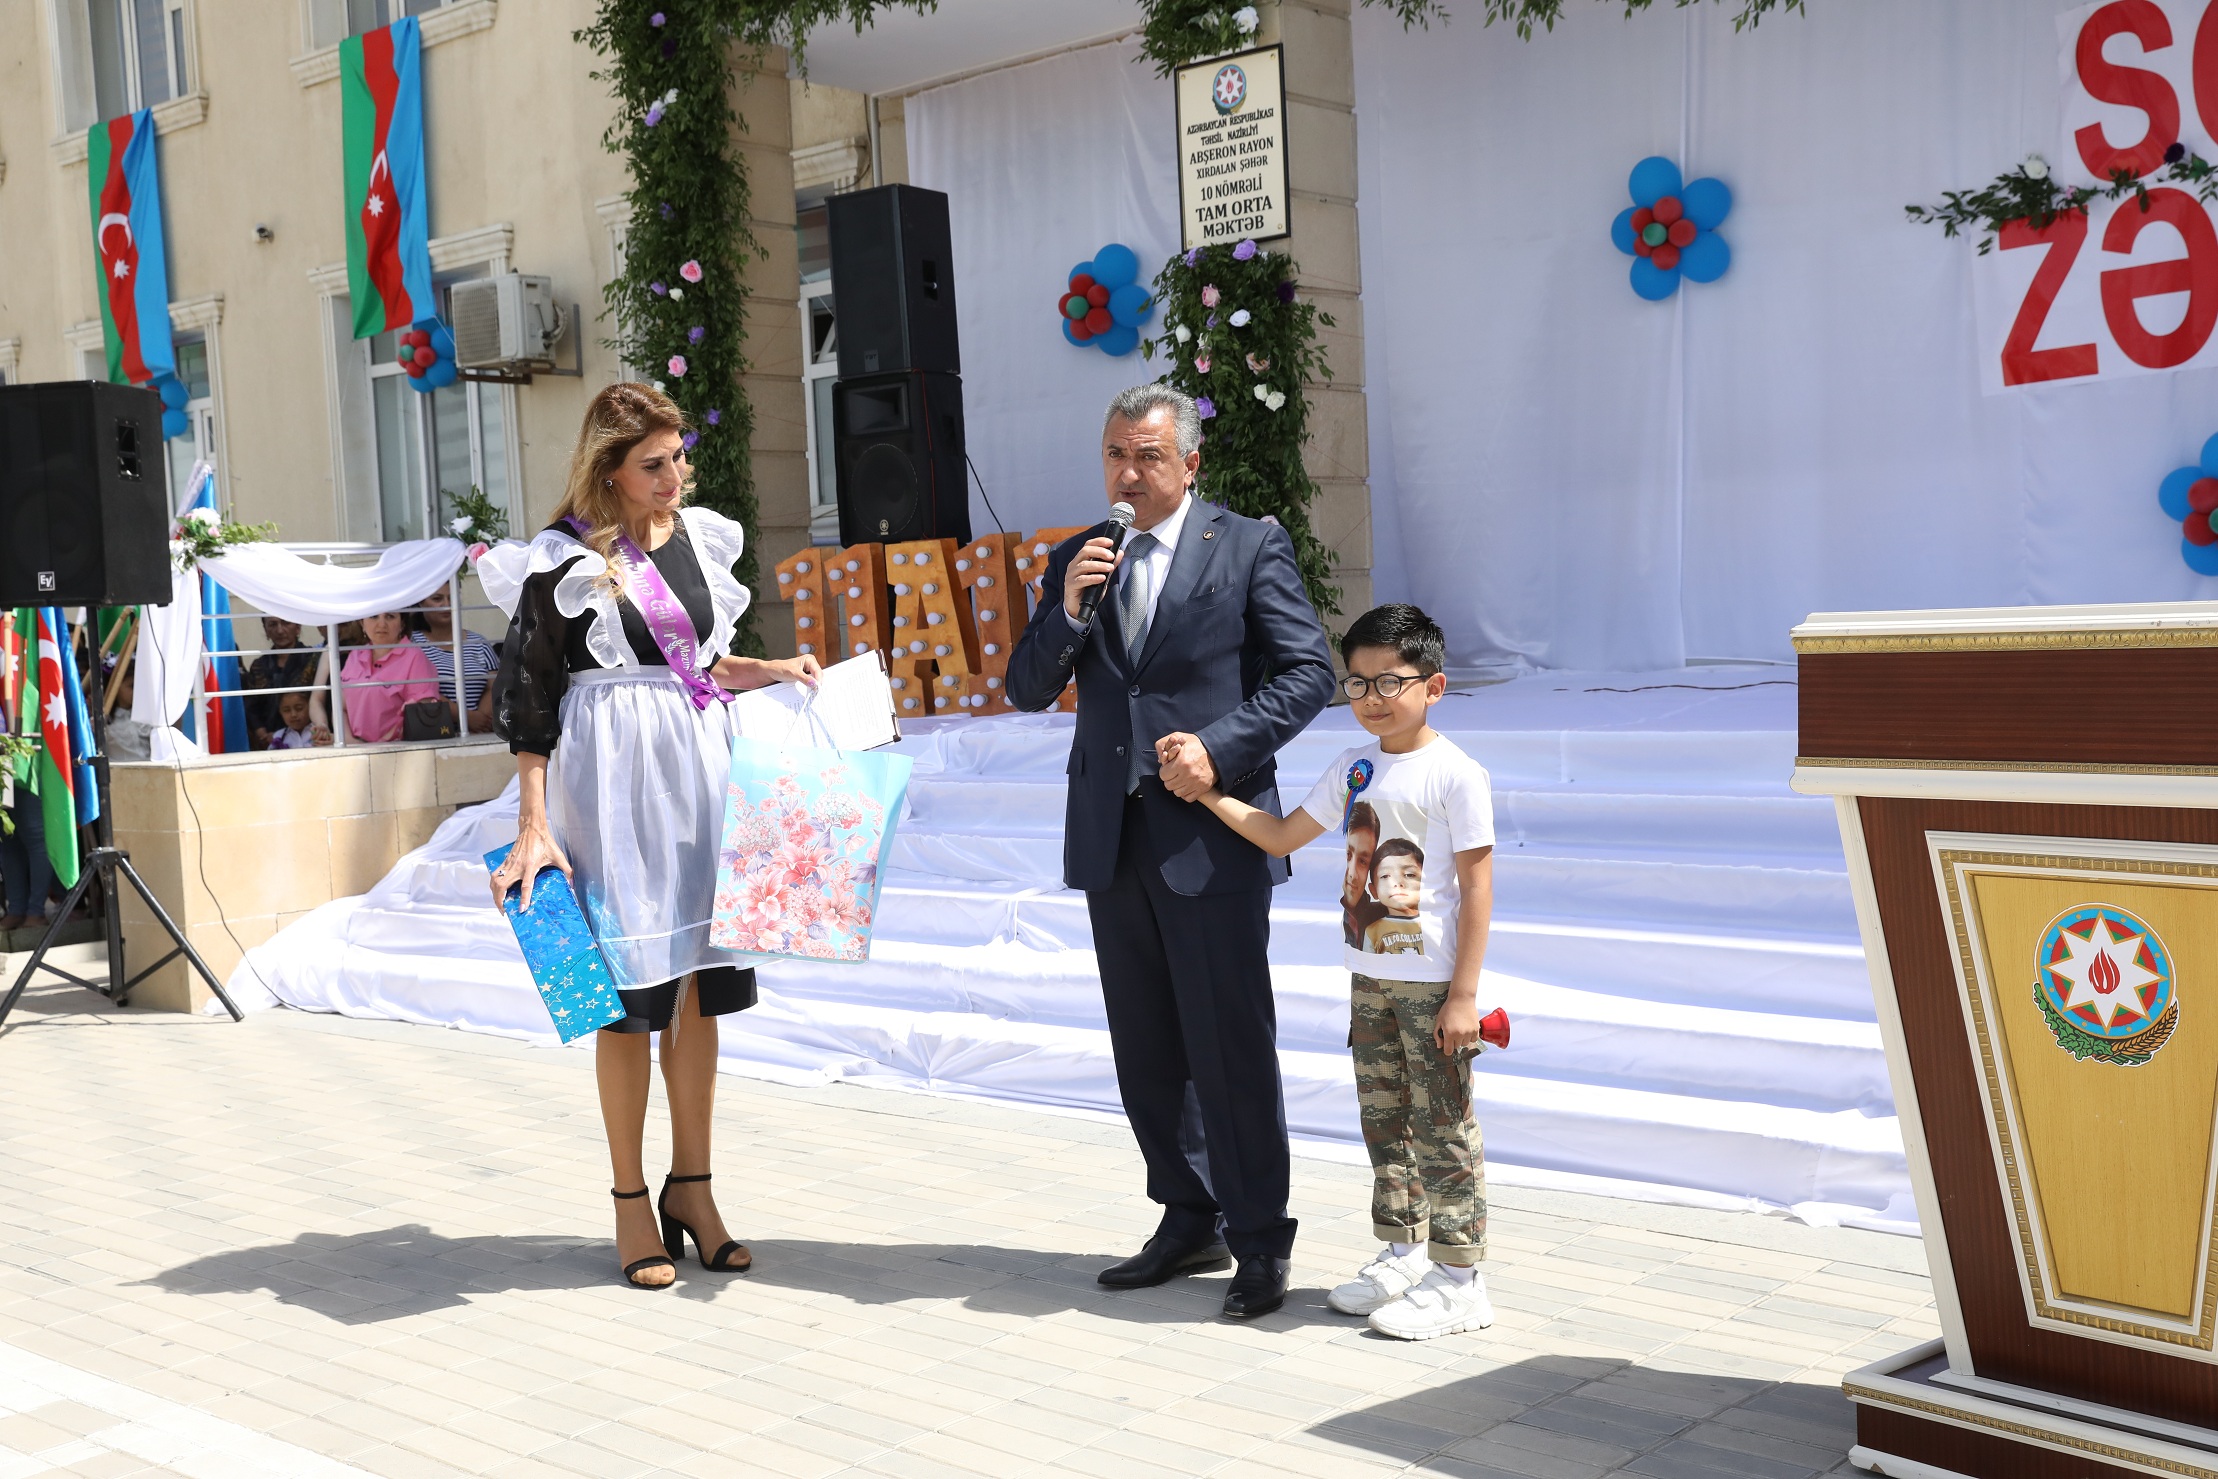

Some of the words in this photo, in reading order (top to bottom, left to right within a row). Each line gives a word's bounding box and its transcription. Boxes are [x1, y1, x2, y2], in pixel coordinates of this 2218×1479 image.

[2074, 0, 2218, 182] S
[1189, 144, 1237, 165] ABŞERON
[1239, 136, 1274, 155] RAYON
[1196, 161, 1237, 179] XIRDALAN
[1240, 155, 1268, 172] ŞƏHƏR
[1201, 186, 1213, 201] 10
[1215, 173, 1262, 198] NÖMRƏLİ
[1195, 203, 1227, 222] TAM
[1231, 195, 1273, 216] ORTA
[1203, 215, 1264, 238] MƏKTƏB
